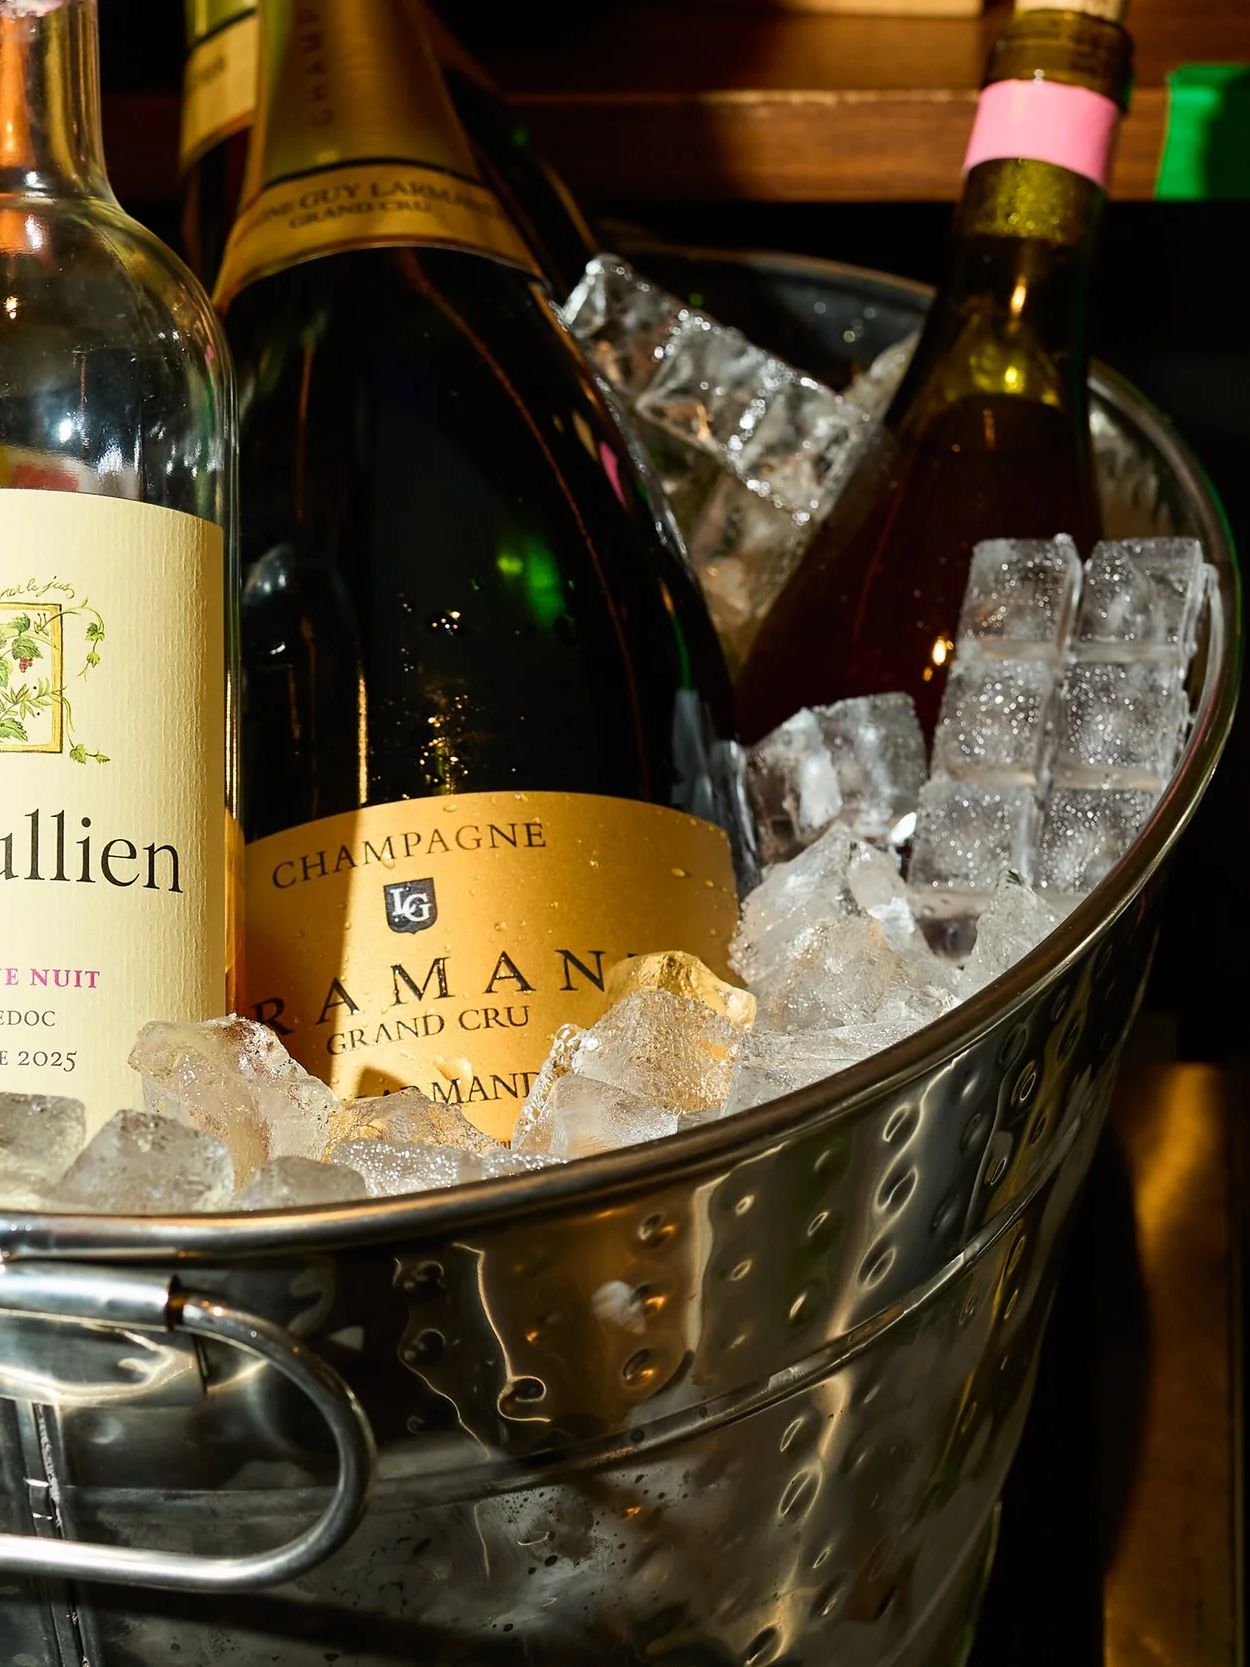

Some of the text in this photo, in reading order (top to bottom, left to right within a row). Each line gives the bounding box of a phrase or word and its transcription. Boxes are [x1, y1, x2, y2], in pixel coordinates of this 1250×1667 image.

[288, 201, 373, 230] GRAND
[379, 200, 432, 214] CRU
[271, 823, 547, 890] CHAMPAGNE
[29, 968, 101, 989] NUIT
[250, 949, 638, 1036] RAMAN
[326, 1005, 531, 1057] GRAND CRU
[17, 1051, 78, 1073] 2025
